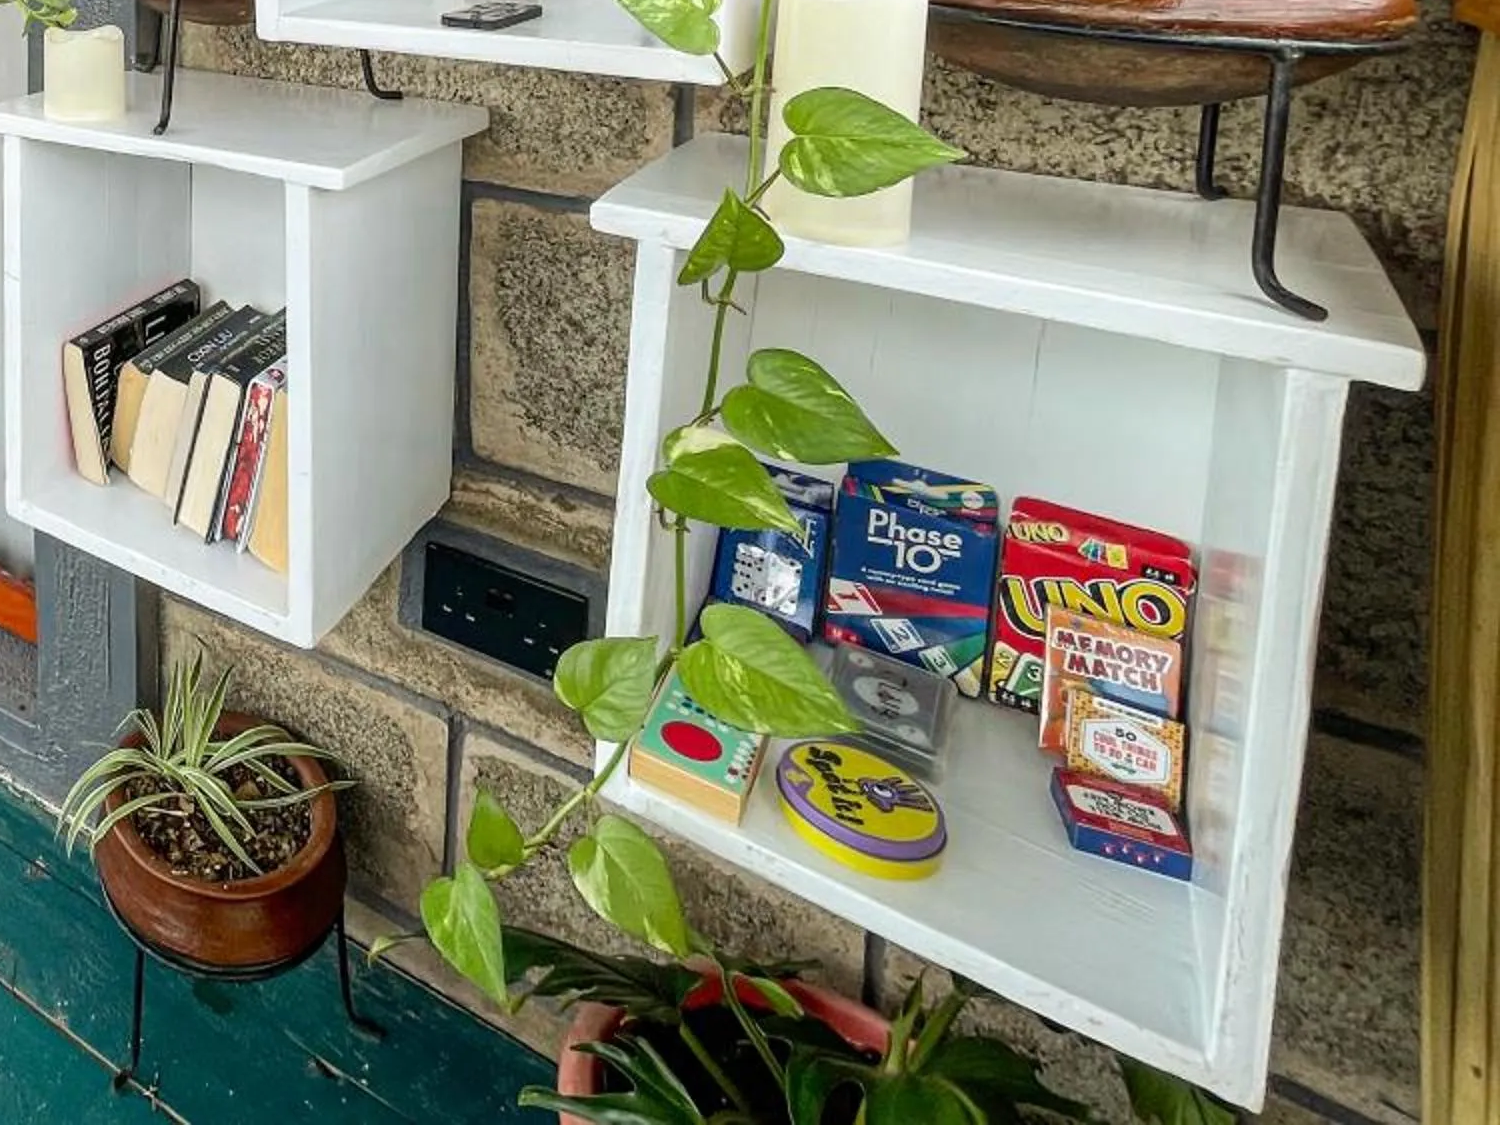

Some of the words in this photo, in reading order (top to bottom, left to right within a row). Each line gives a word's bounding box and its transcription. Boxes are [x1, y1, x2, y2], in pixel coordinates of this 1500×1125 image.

[868, 508, 963, 550] Phase
[1010, 523, 1069, 543] UNO
[894, 542, 942, 574] 10
[1000, 576, 1186, 640] UNO
[1056, 630, 1169, 673] MEMORY
[1068, 653, 1157, 691] MATCH
[1115, 728, 1137, 742] 50
